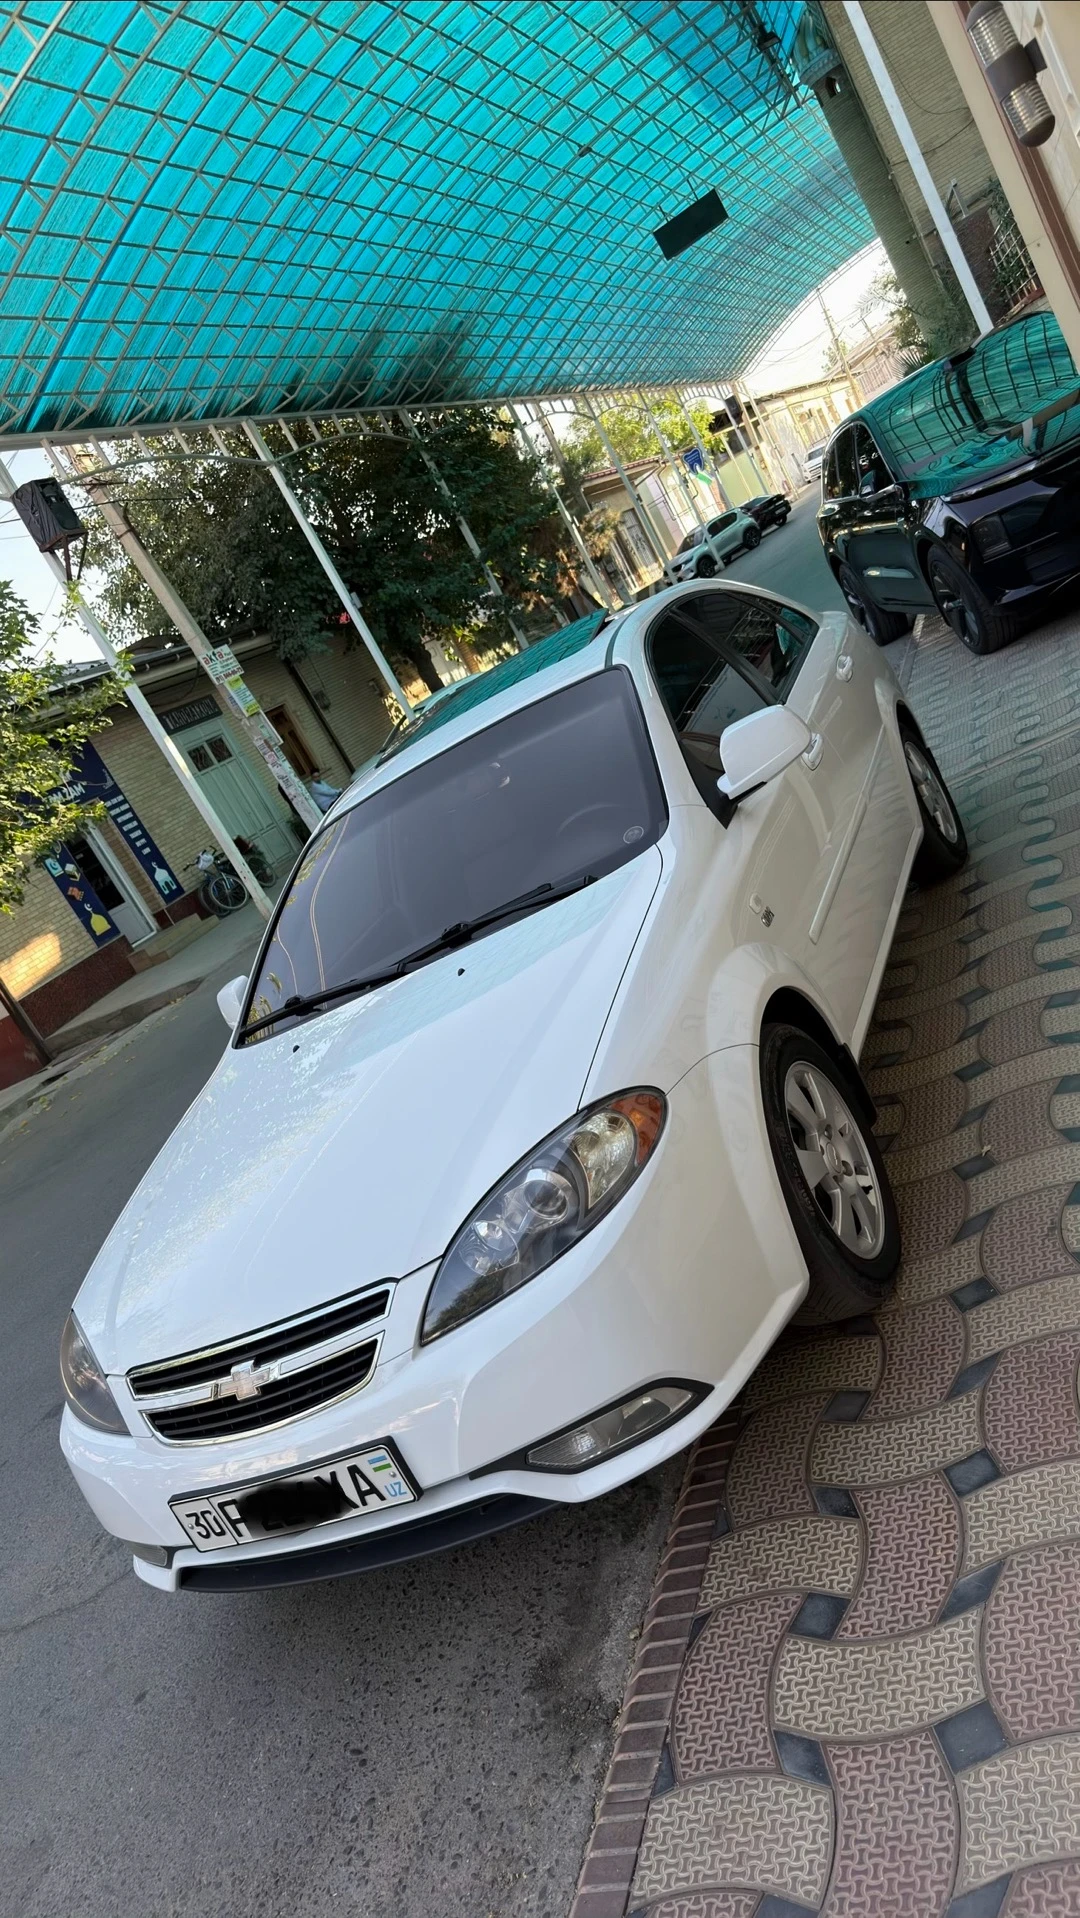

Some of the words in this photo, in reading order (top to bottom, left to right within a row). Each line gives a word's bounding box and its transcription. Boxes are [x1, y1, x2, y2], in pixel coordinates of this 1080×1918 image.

[202, 650, 225, 666] akfa
[184, 1509, 227, 1540] 30
[384, 1481, 408, 1498] UZ
